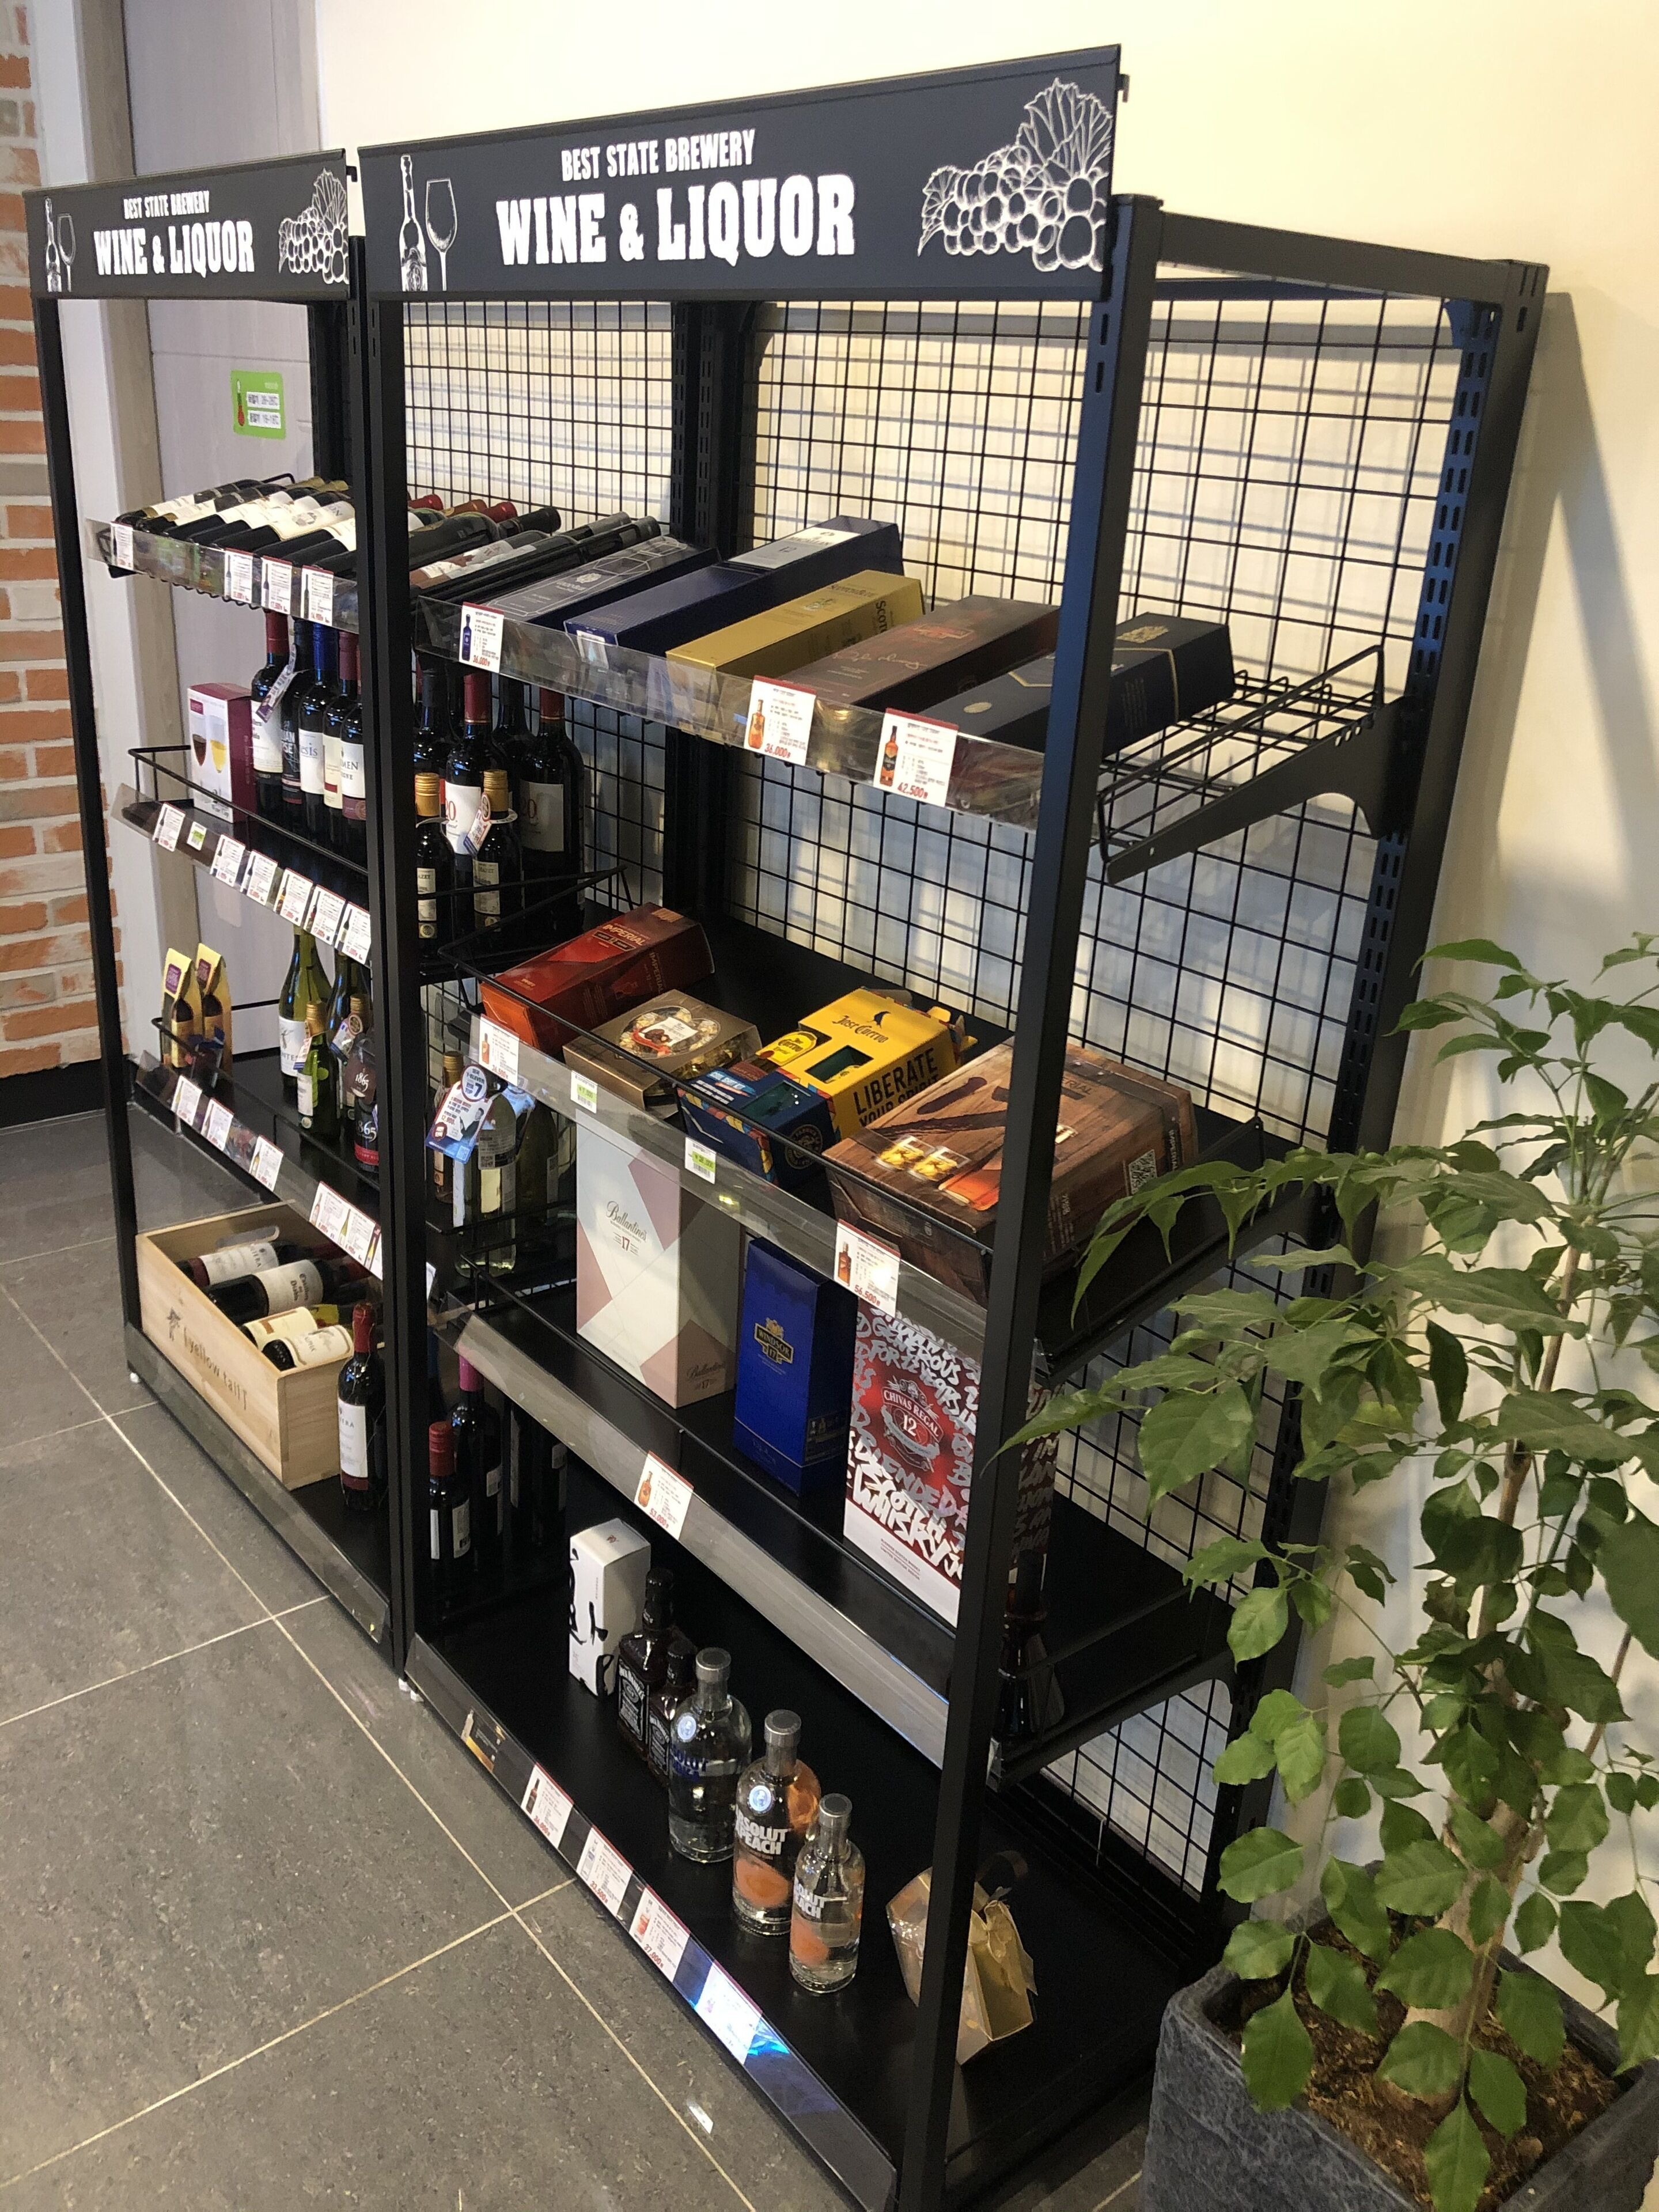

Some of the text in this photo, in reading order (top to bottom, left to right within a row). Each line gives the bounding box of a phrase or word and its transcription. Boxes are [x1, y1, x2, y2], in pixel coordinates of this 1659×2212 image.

[561, 128, 756, 182] BEST STATE BREWERY
[123, 190, 210, 220] BEST STATE BREWERY
[495, 174, 855, 267] WINE & LIQUOR
[93, 219, 255, 278] WINE & LIQUOR
[602, 923, 646, 946] IMPERIAL
[473, 1082, 483, 1098] 7
[853, 1047, 938, 1116] LIBERATE
[1062, 1077, 1092, 1095] ERIAL
[605, 1200, 647, 1241] Ballantine's
[622, 1236, 631, 1252] 17
[758, 1329, 790, 1357] WINDSOR
[883, 1389, 913, 1410] CHIVAS
[913, 1404, 940, 1438] REGAL
[903, 1414, 918, 1437] 12
